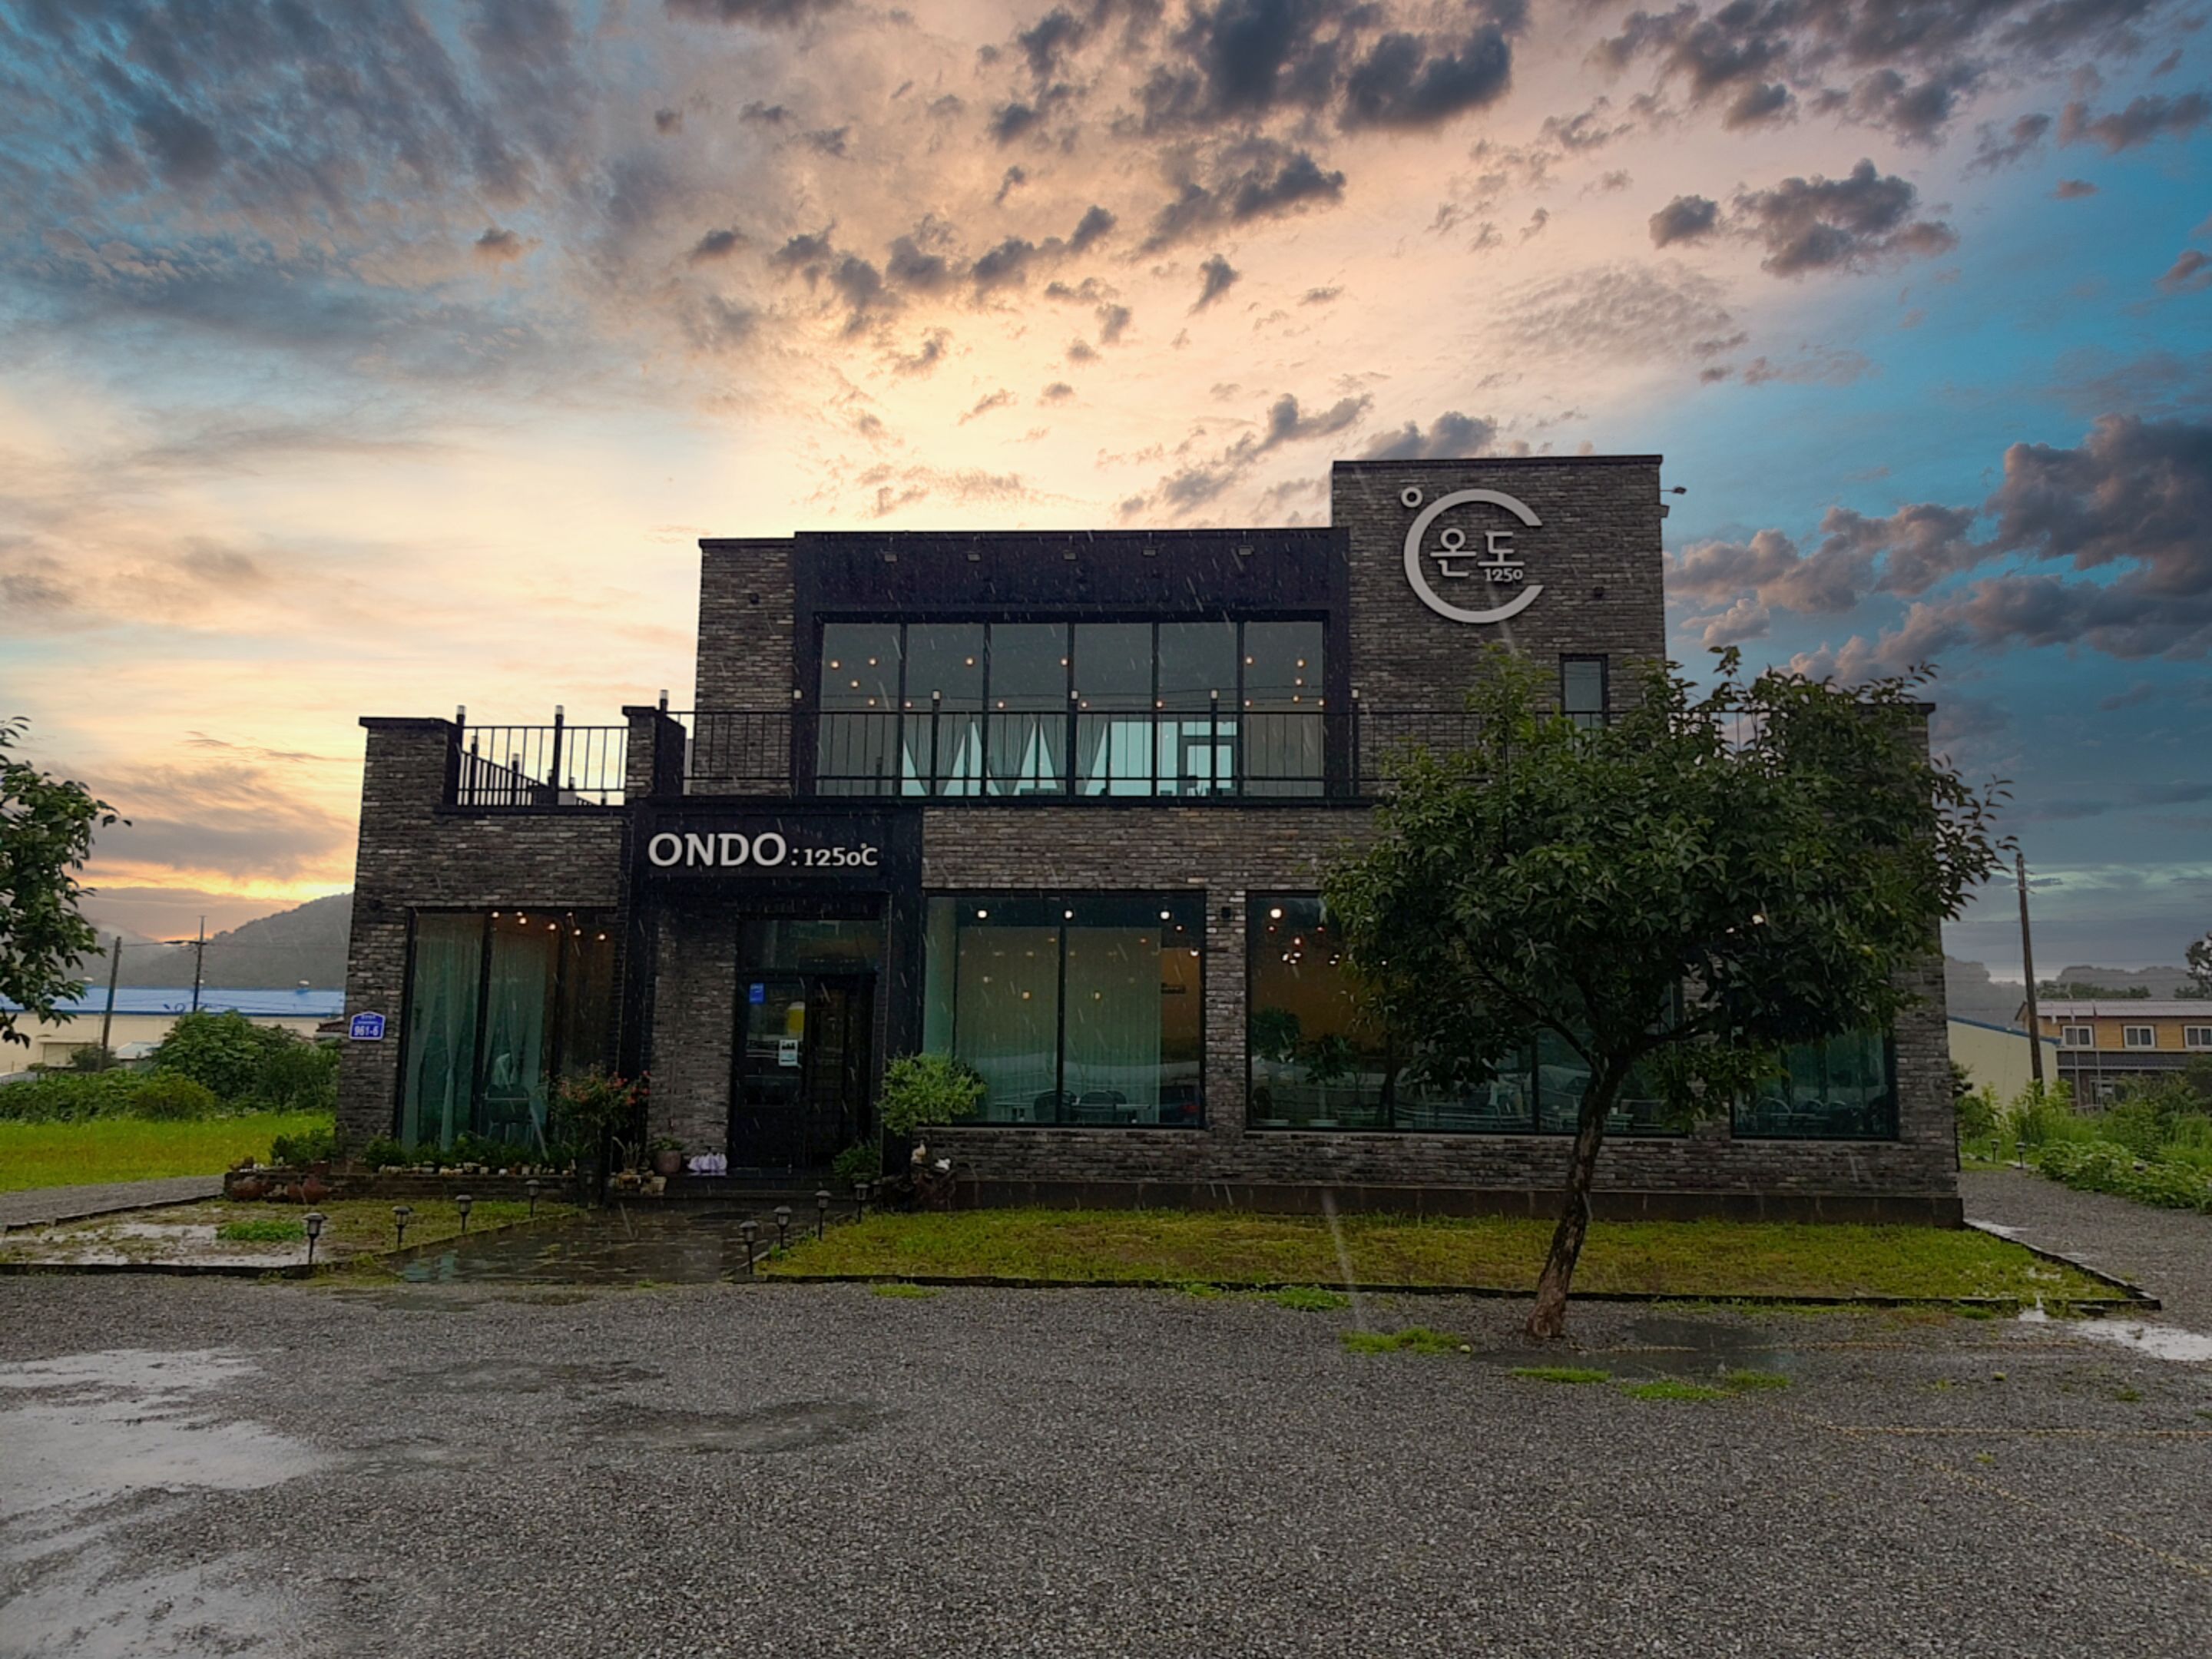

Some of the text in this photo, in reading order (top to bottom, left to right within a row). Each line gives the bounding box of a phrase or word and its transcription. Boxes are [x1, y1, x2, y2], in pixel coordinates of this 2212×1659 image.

[1429, 528, 1525, 577] 온도
[1483, 568, 1524, 582] 1250
[648, 832, 786, 866] ONDO
